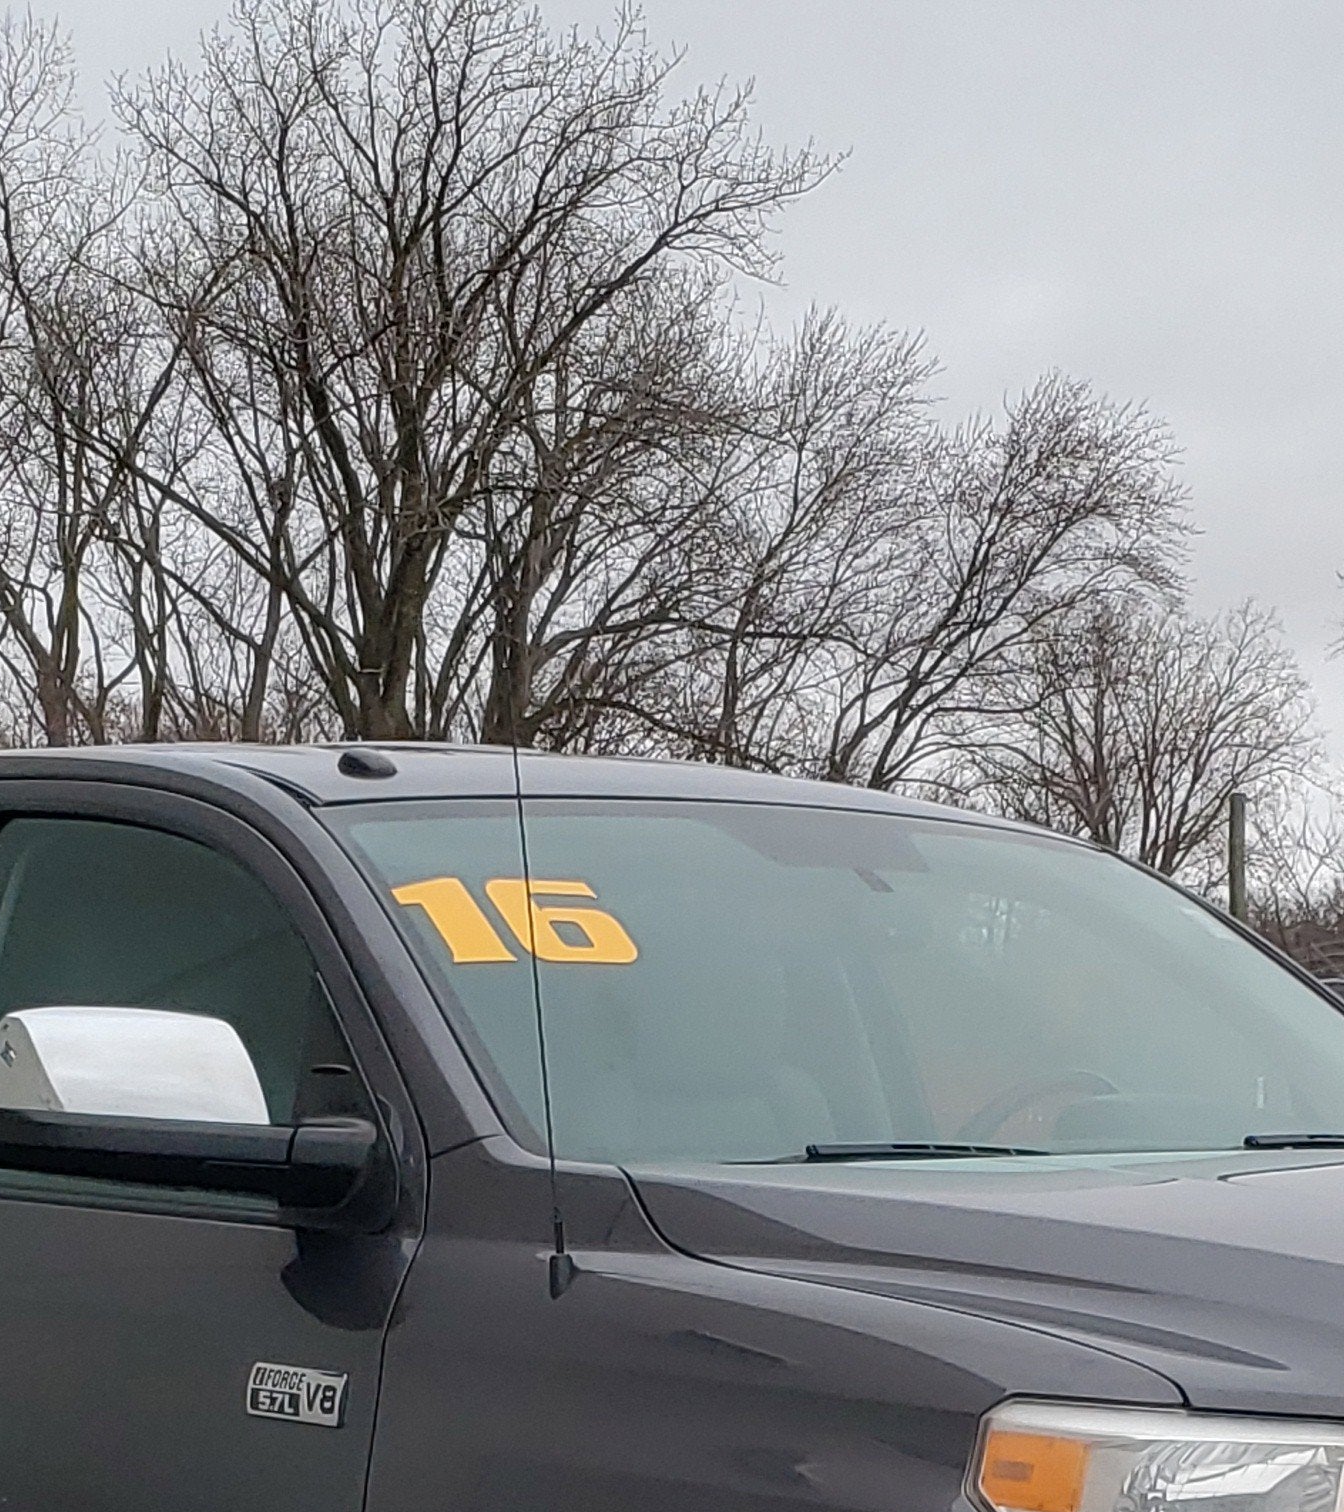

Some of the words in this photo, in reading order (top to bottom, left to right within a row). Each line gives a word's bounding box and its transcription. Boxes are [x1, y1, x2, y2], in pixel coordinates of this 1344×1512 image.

[391, 877, 638, 964] 16
[257, 1390, 295, 1414] 5.7L
[305, 1381, 338, 1415] V8
